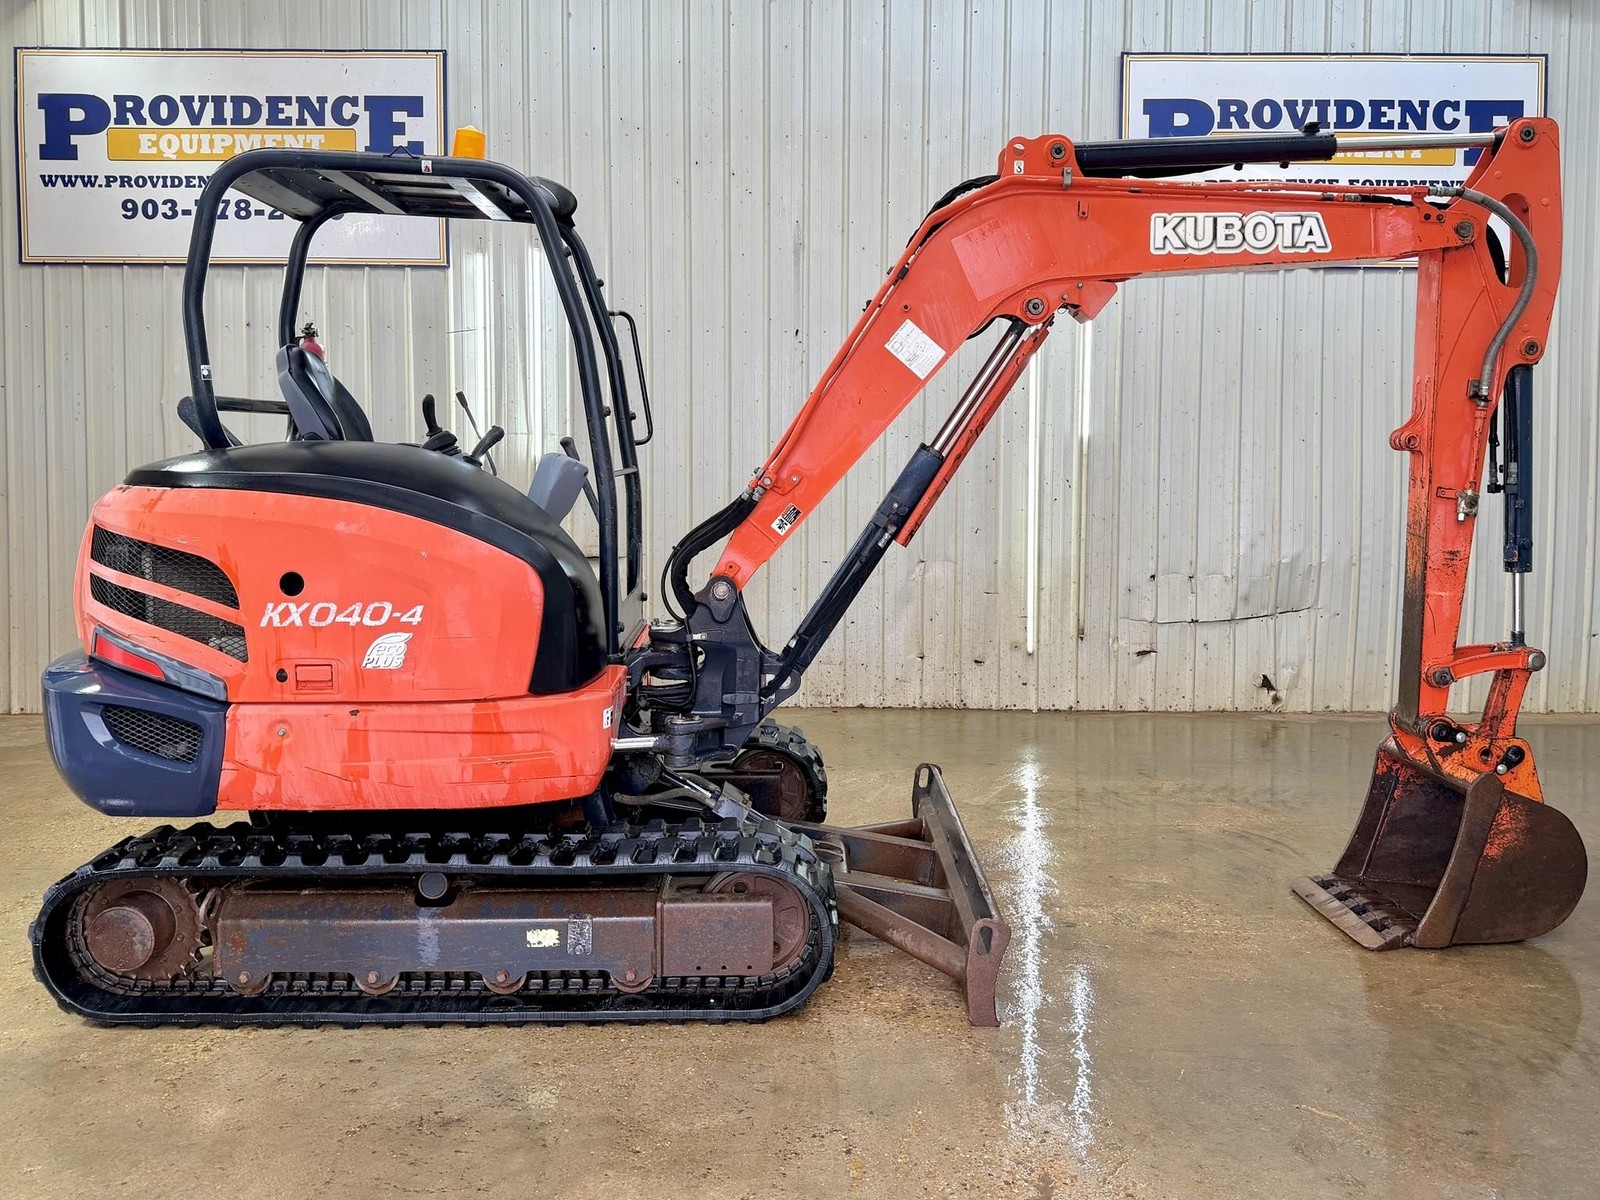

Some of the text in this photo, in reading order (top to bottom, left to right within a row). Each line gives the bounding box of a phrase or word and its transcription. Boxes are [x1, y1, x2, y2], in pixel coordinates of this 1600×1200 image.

[37, 94, 424, 161] PROVIDENCE
[138, 133, 325, 160] EQUIPMENT
[1153, 213, 1329, 252] KUBOTA
[259, 600, 424, 628] KX040-4
[363, 656, 405, 669] PLUS
